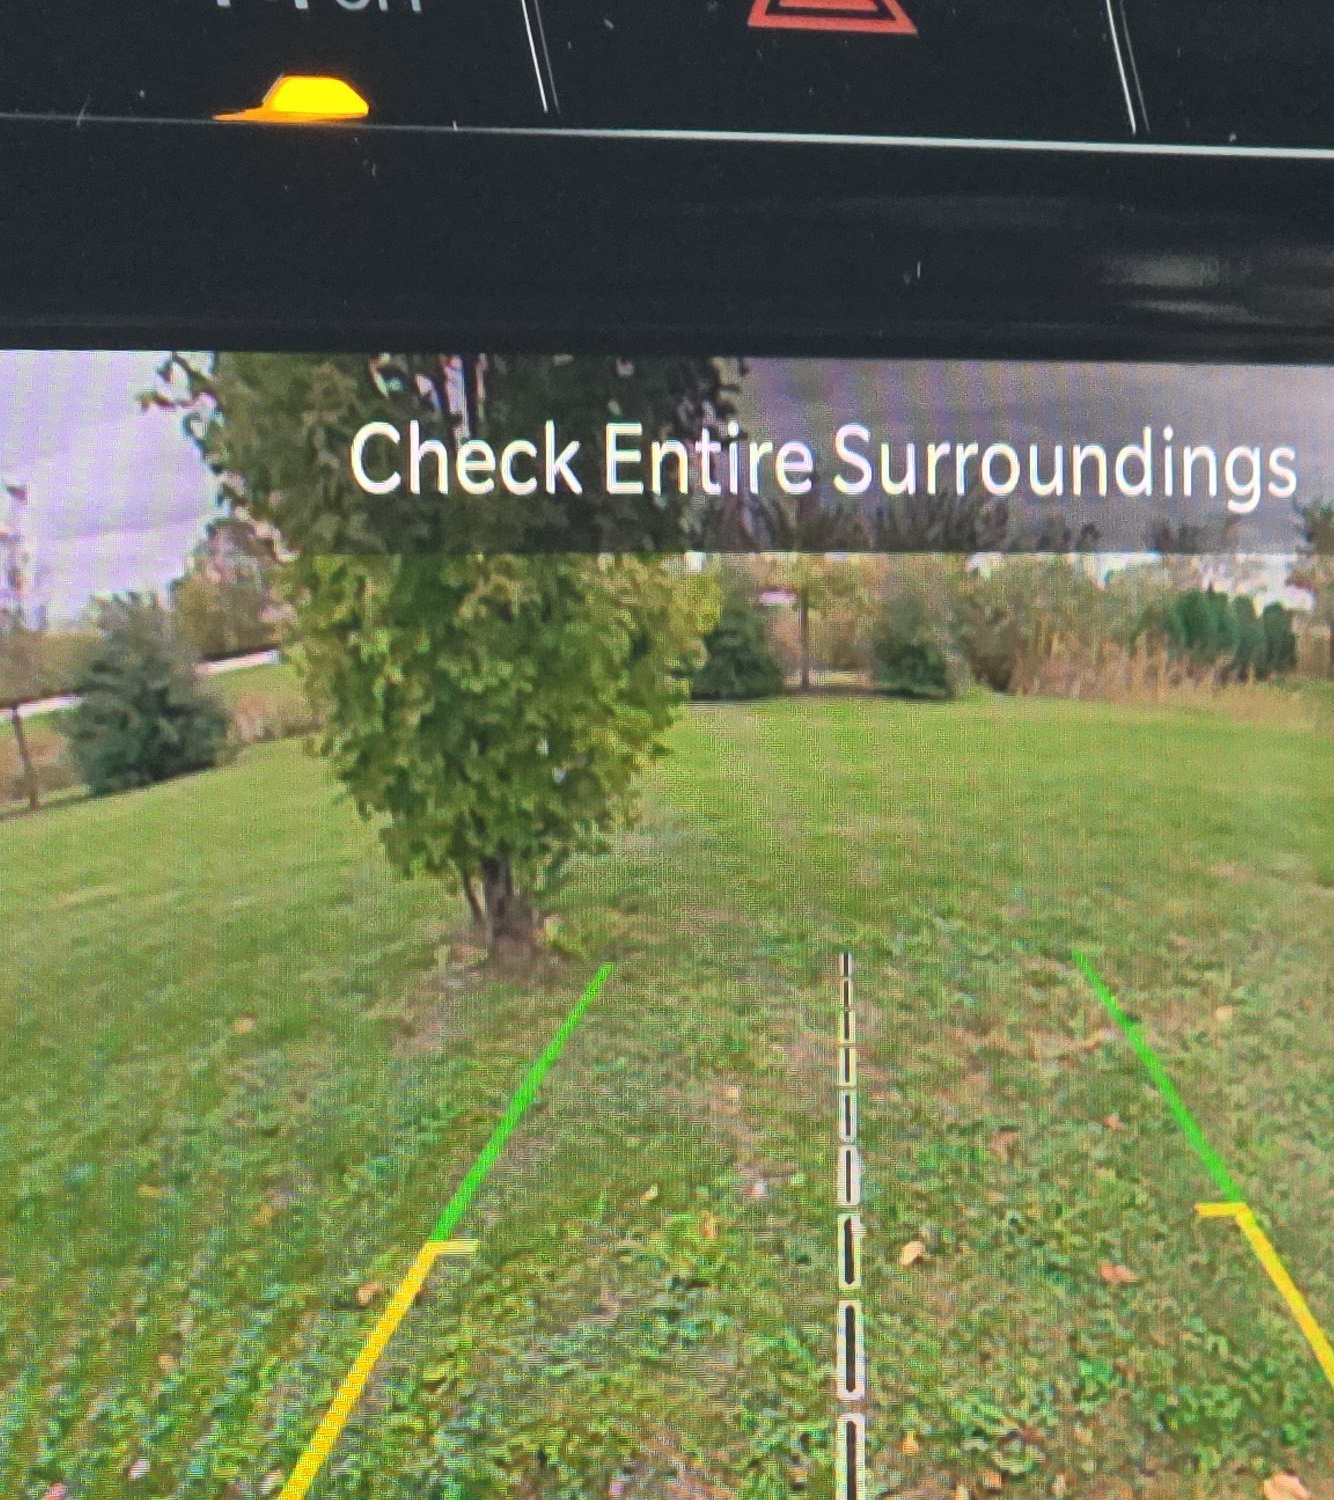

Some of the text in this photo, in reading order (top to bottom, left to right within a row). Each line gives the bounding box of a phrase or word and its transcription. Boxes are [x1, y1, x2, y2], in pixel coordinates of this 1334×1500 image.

[351, 419, 1299, 514] Check Entire Surroundings
